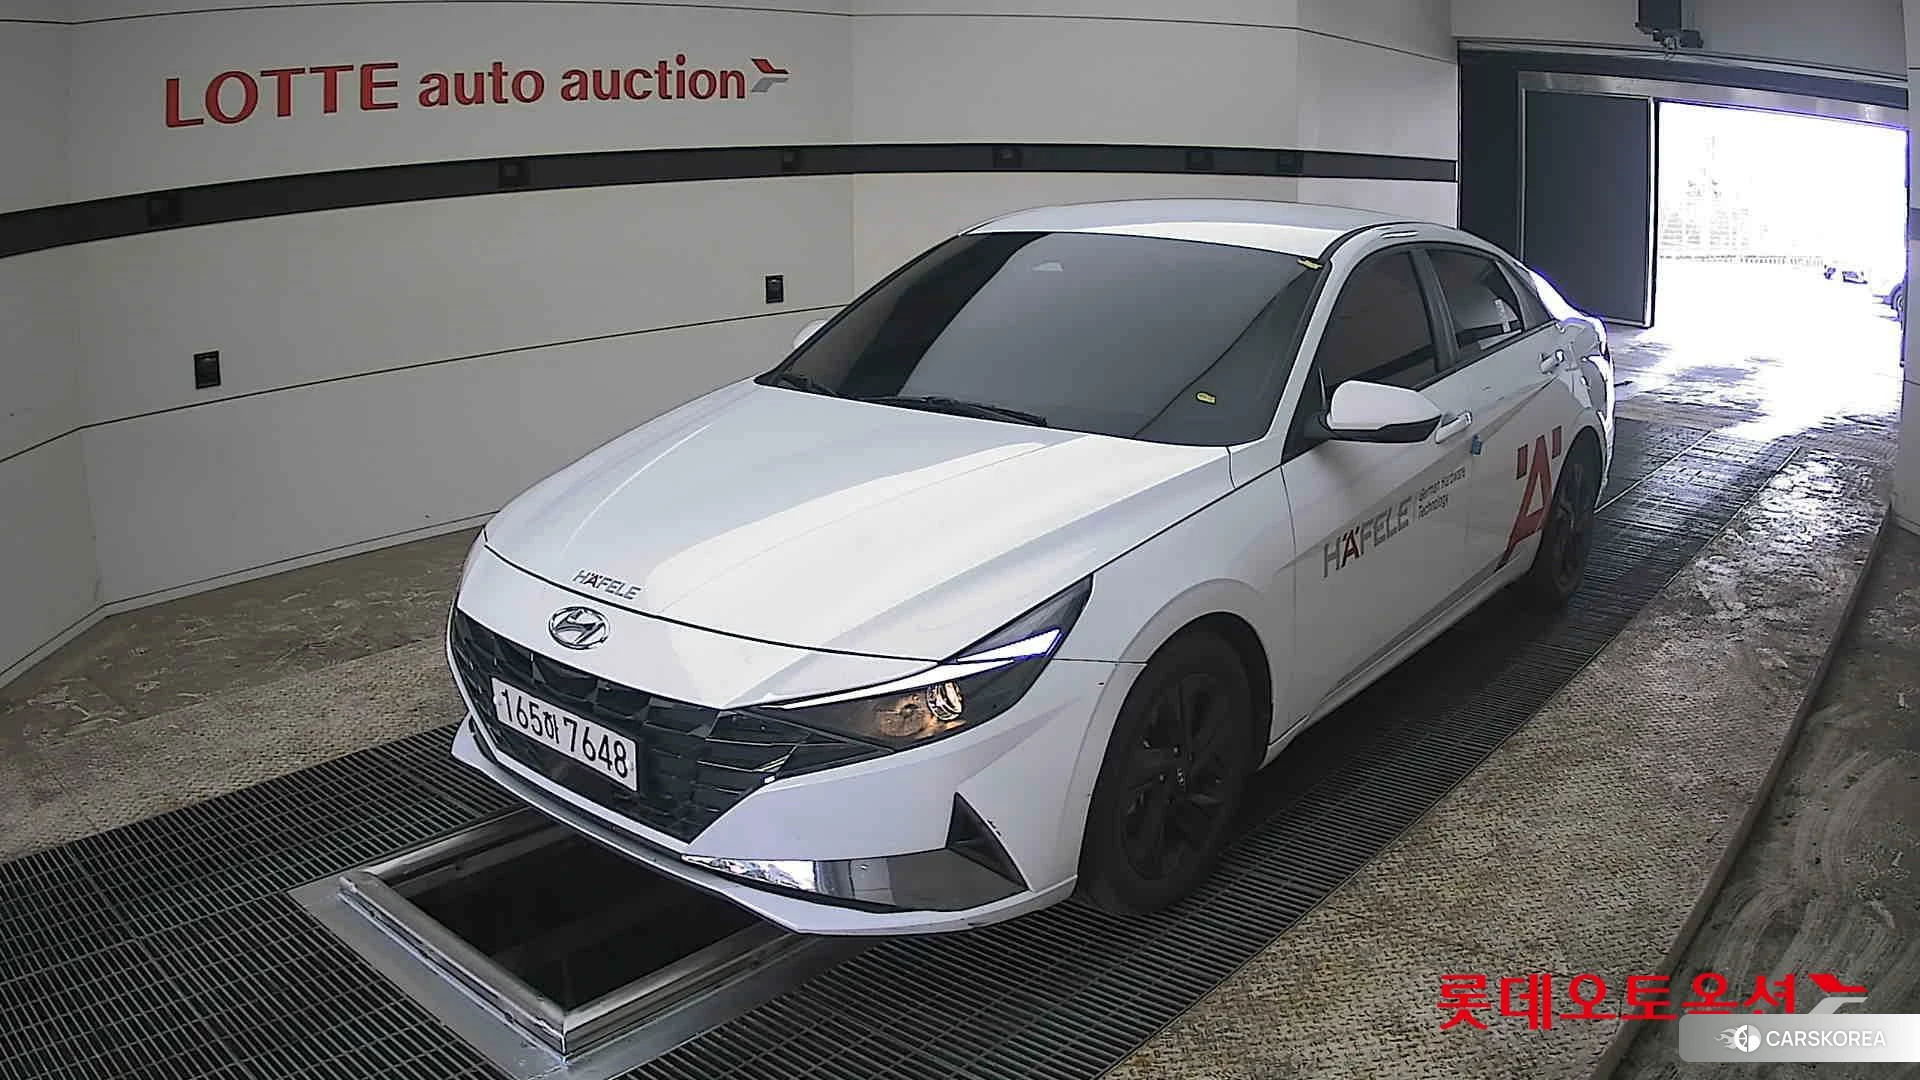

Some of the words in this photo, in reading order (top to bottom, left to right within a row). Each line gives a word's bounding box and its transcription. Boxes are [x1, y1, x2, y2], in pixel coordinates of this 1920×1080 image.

[165, 62, 398, 128] LOTTE
[418, 61, 544, 107] auto
[560, 54, 746, 100] auction
[1322, 496, 1413, 578] HÄFELE
[572, 570, 642, 600] HÄFELE
